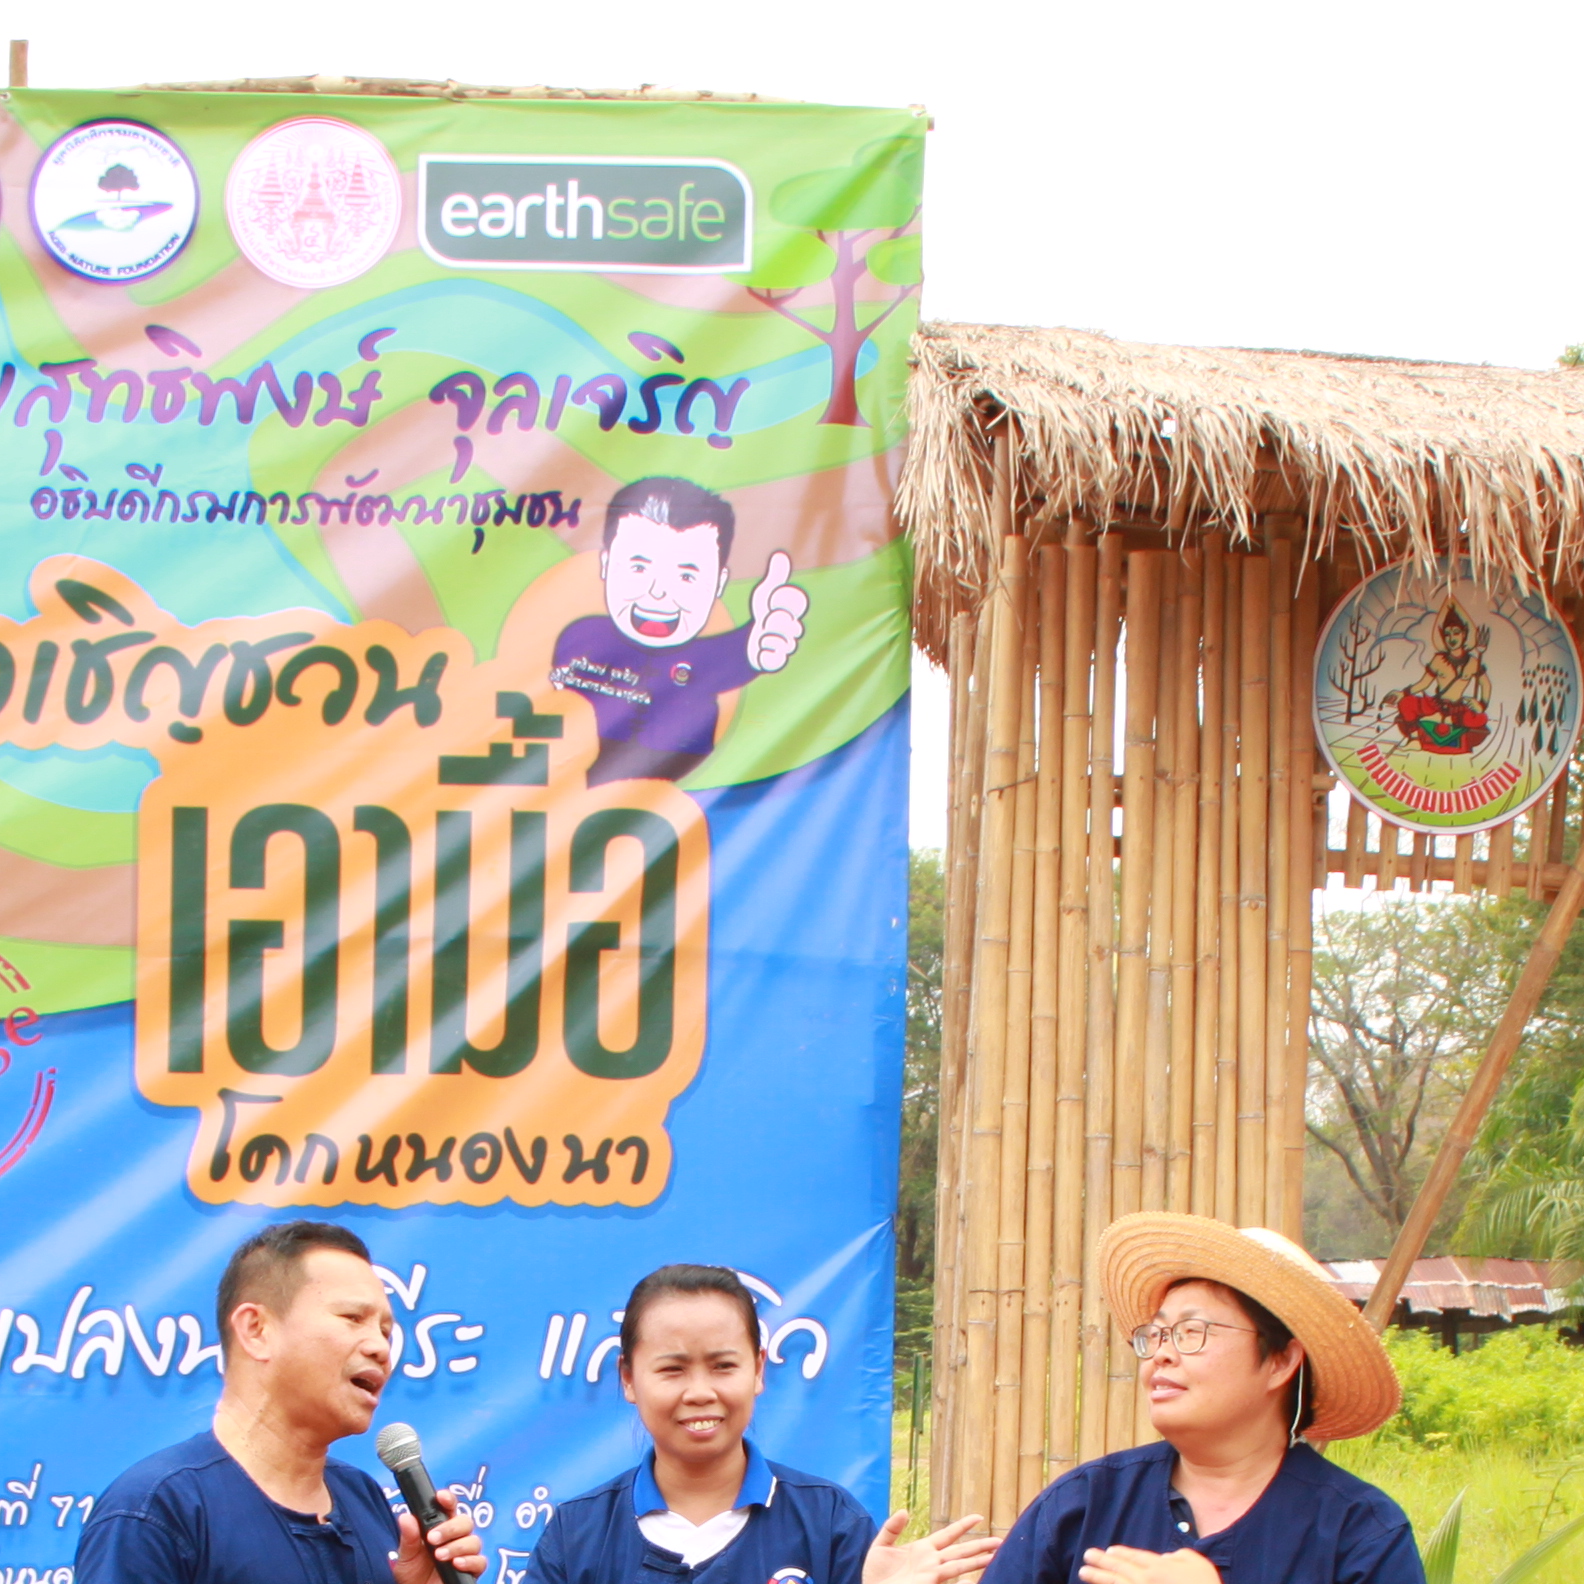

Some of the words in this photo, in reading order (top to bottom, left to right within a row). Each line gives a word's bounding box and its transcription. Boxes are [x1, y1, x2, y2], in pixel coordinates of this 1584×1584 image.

[428, 331, 752, 483] จุลเจริญ
[30, 462, 582, 555] อธิบดีกรมการพัฒนาชุมชน
[166, 690, 680, 1081] เอามื้อ
